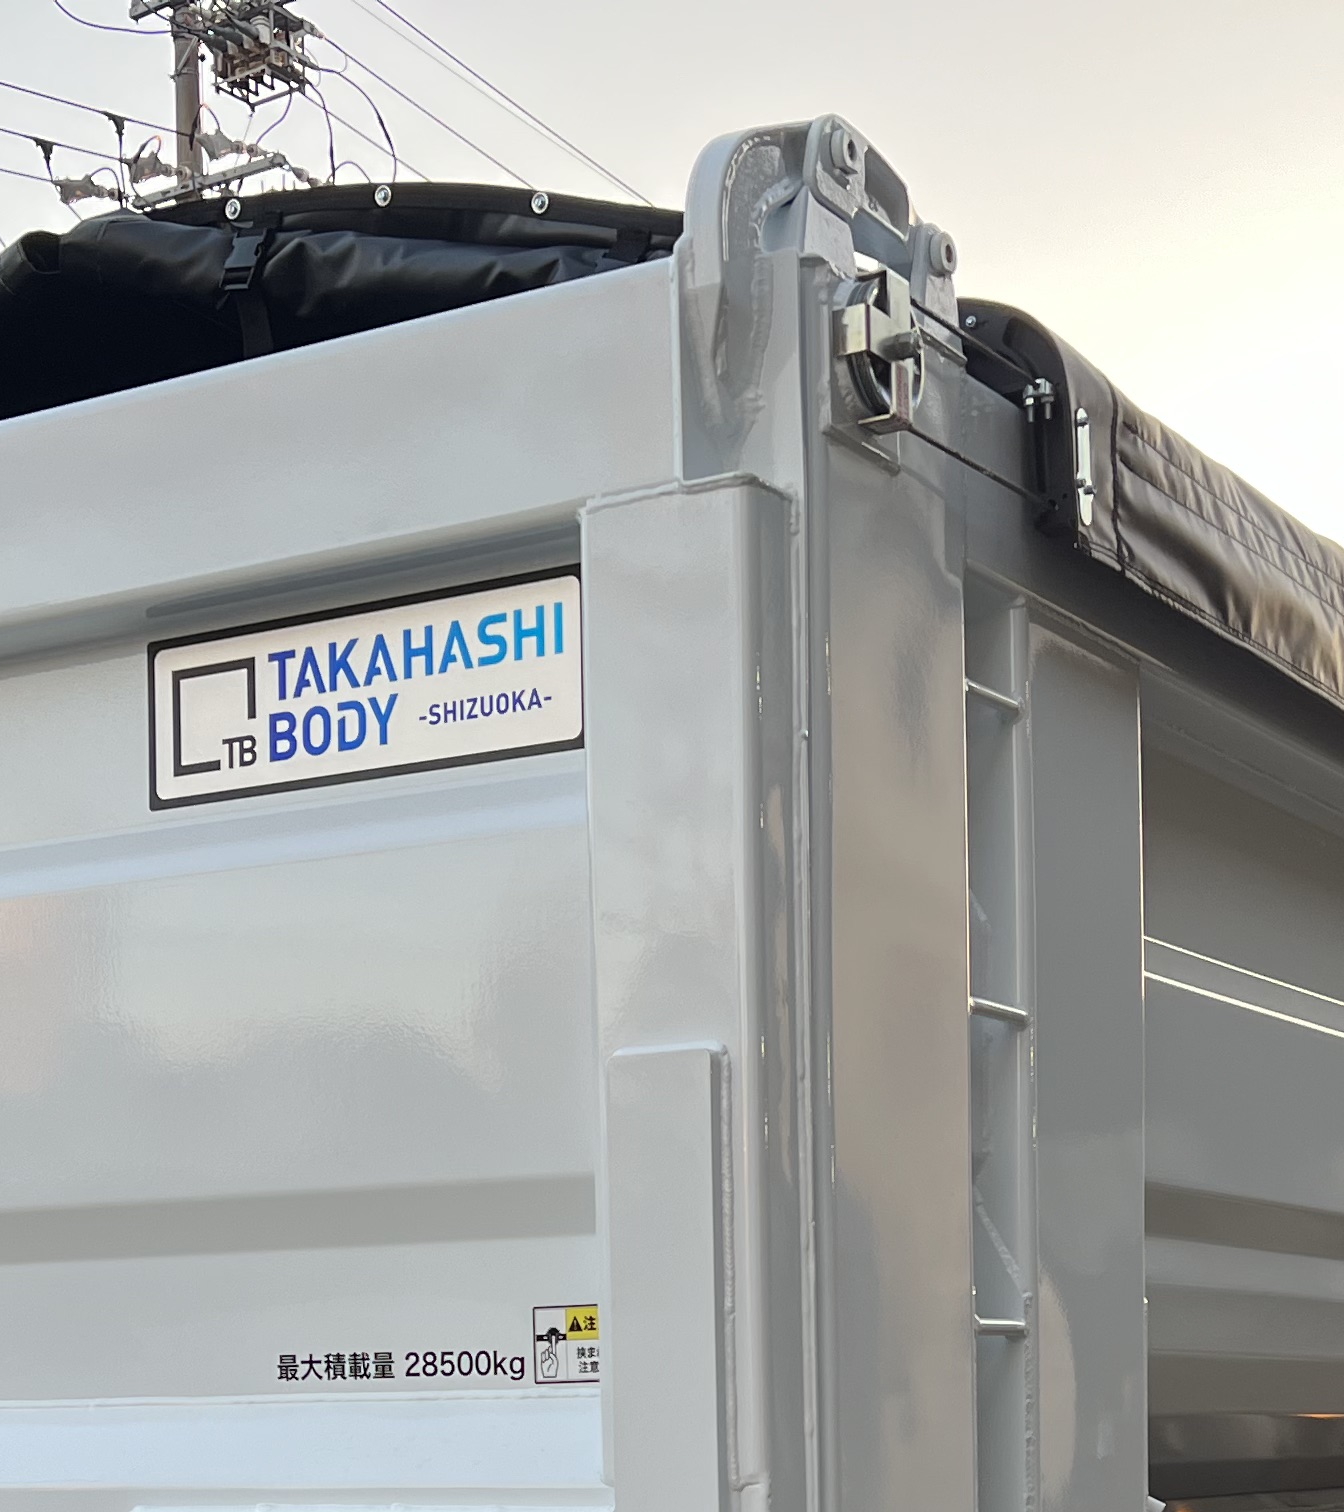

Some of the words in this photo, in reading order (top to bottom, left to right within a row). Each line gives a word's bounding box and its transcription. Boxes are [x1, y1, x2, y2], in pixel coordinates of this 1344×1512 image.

[268, 601, 564, 701] TAKAHASHI
[222, 734, 257, 769] TB
[269, 693, 398, 762] BODY
[276, 1352, 395, 1381] 最大積載量
[404, 1350, 525, 1381] 28500kg
